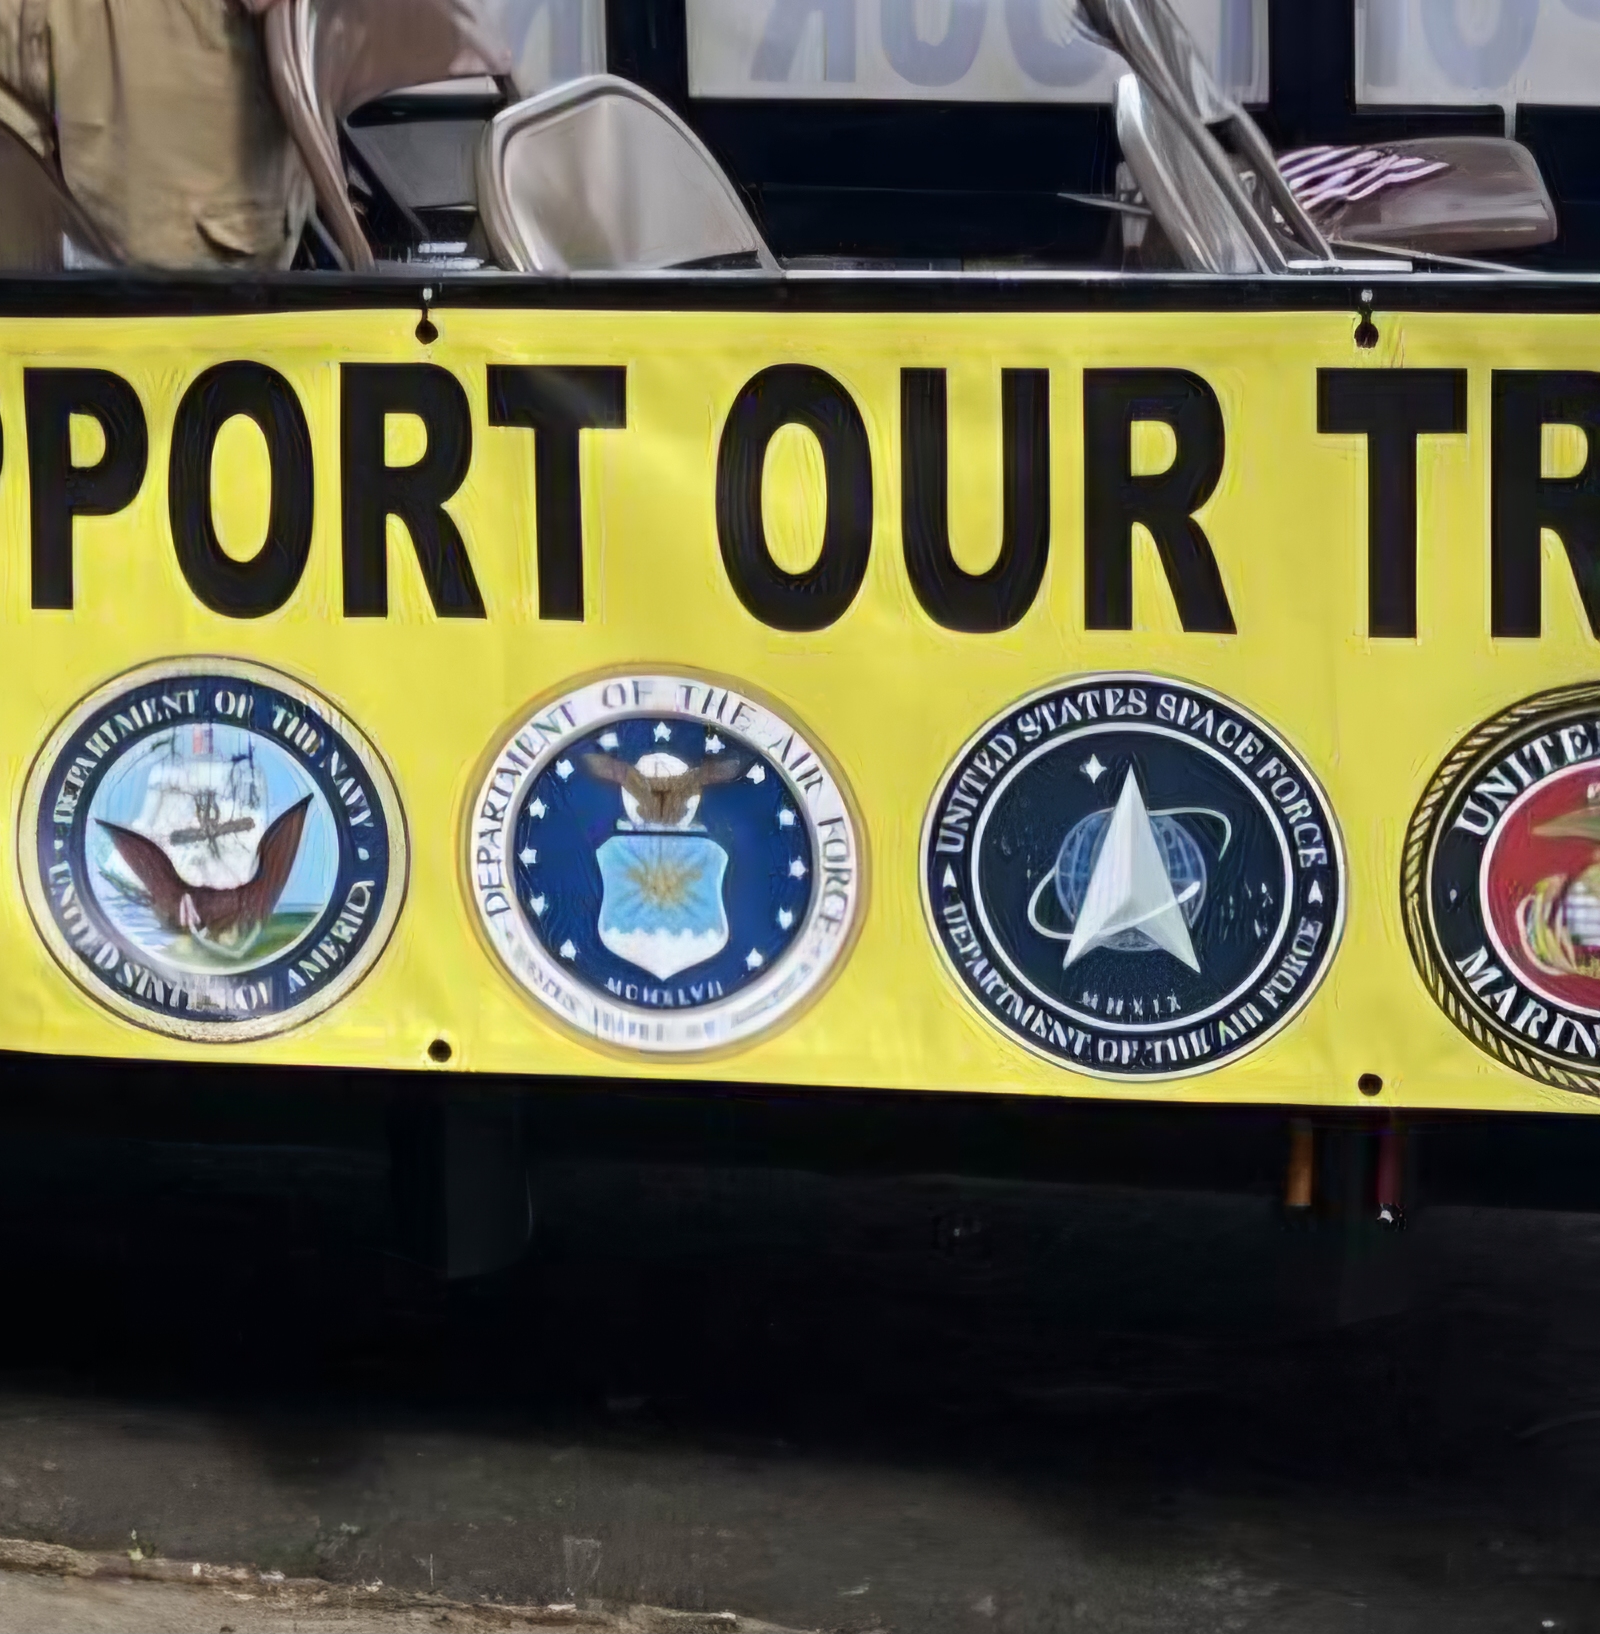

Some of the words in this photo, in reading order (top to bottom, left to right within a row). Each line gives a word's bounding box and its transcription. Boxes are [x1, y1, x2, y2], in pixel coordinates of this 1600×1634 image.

[714, 362, 1238, 634] OUR
[1316, 367, 1600, 641] TR
[476, 699, 576, 919] DEPARTMENT
[601, 681, 654, 709] OF
[677, 683, 757, 729] THE
[935, 731, 1017, 856] UNITED
[1016, 688, 1148, 743] STATES
[1155, 692, 1264, 766] SPACE
[1256, 750, 1328, 869] FORCE
[1454, 721, 1600, 837] UNITE
[1455, 945, 1600, 1060] MARIN
